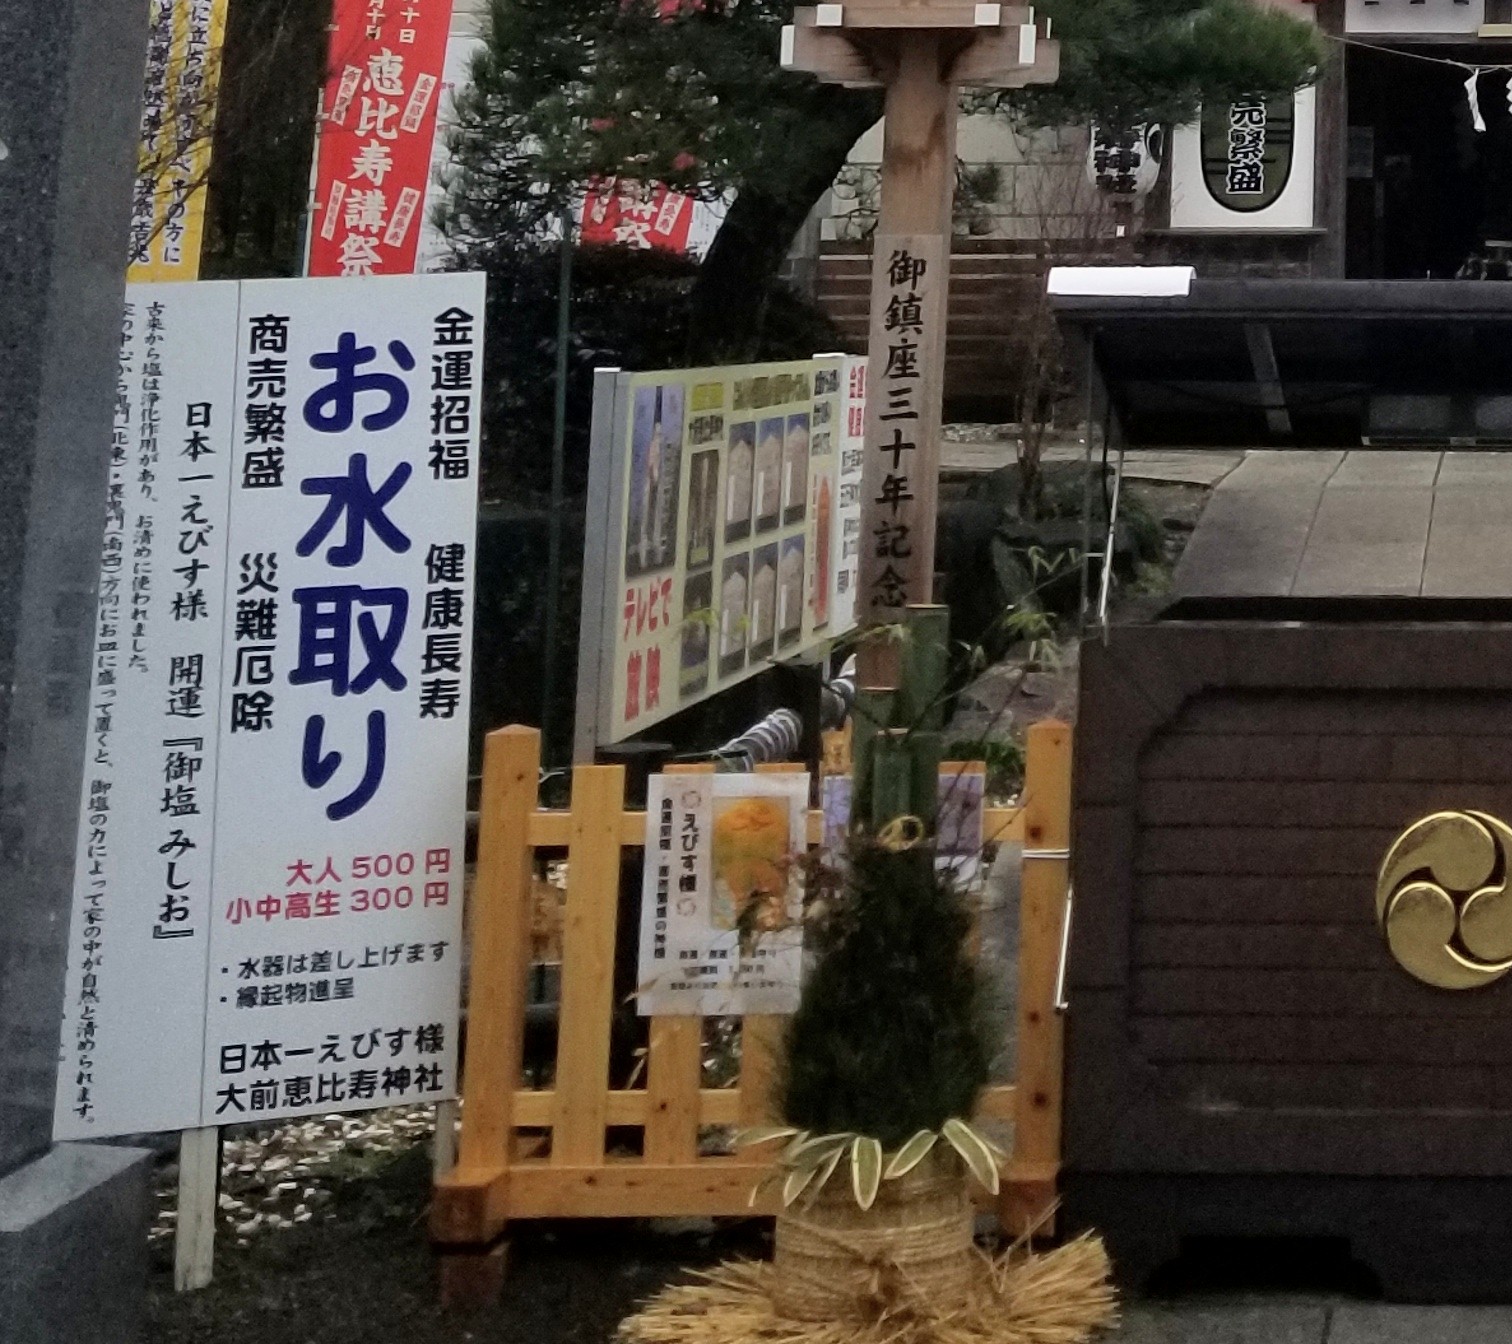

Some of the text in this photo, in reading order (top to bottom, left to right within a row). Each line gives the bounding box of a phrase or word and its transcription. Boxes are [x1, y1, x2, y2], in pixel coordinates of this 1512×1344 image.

[1229, 94, 1264, 193] 売繁盛
[870, 250, 926, 610] 御鎮座三十年記念
[169, 401, 216, 622] 日本一えびす様
[231, 313, 290, 733] 商売繁盛 災難厄除
[288, 331, 415, 821] お水取り
[420, 306, 474, 720] 金運招福 健康長寿
[225, 881, 449, 925] 小中高生 300 円
[286, 848, 450, 887] 大人 500 円
[215, 1063, 443, 1114] 大前恵比寿神社
[219, 1021, 445, 1075] 日本一えびす様
